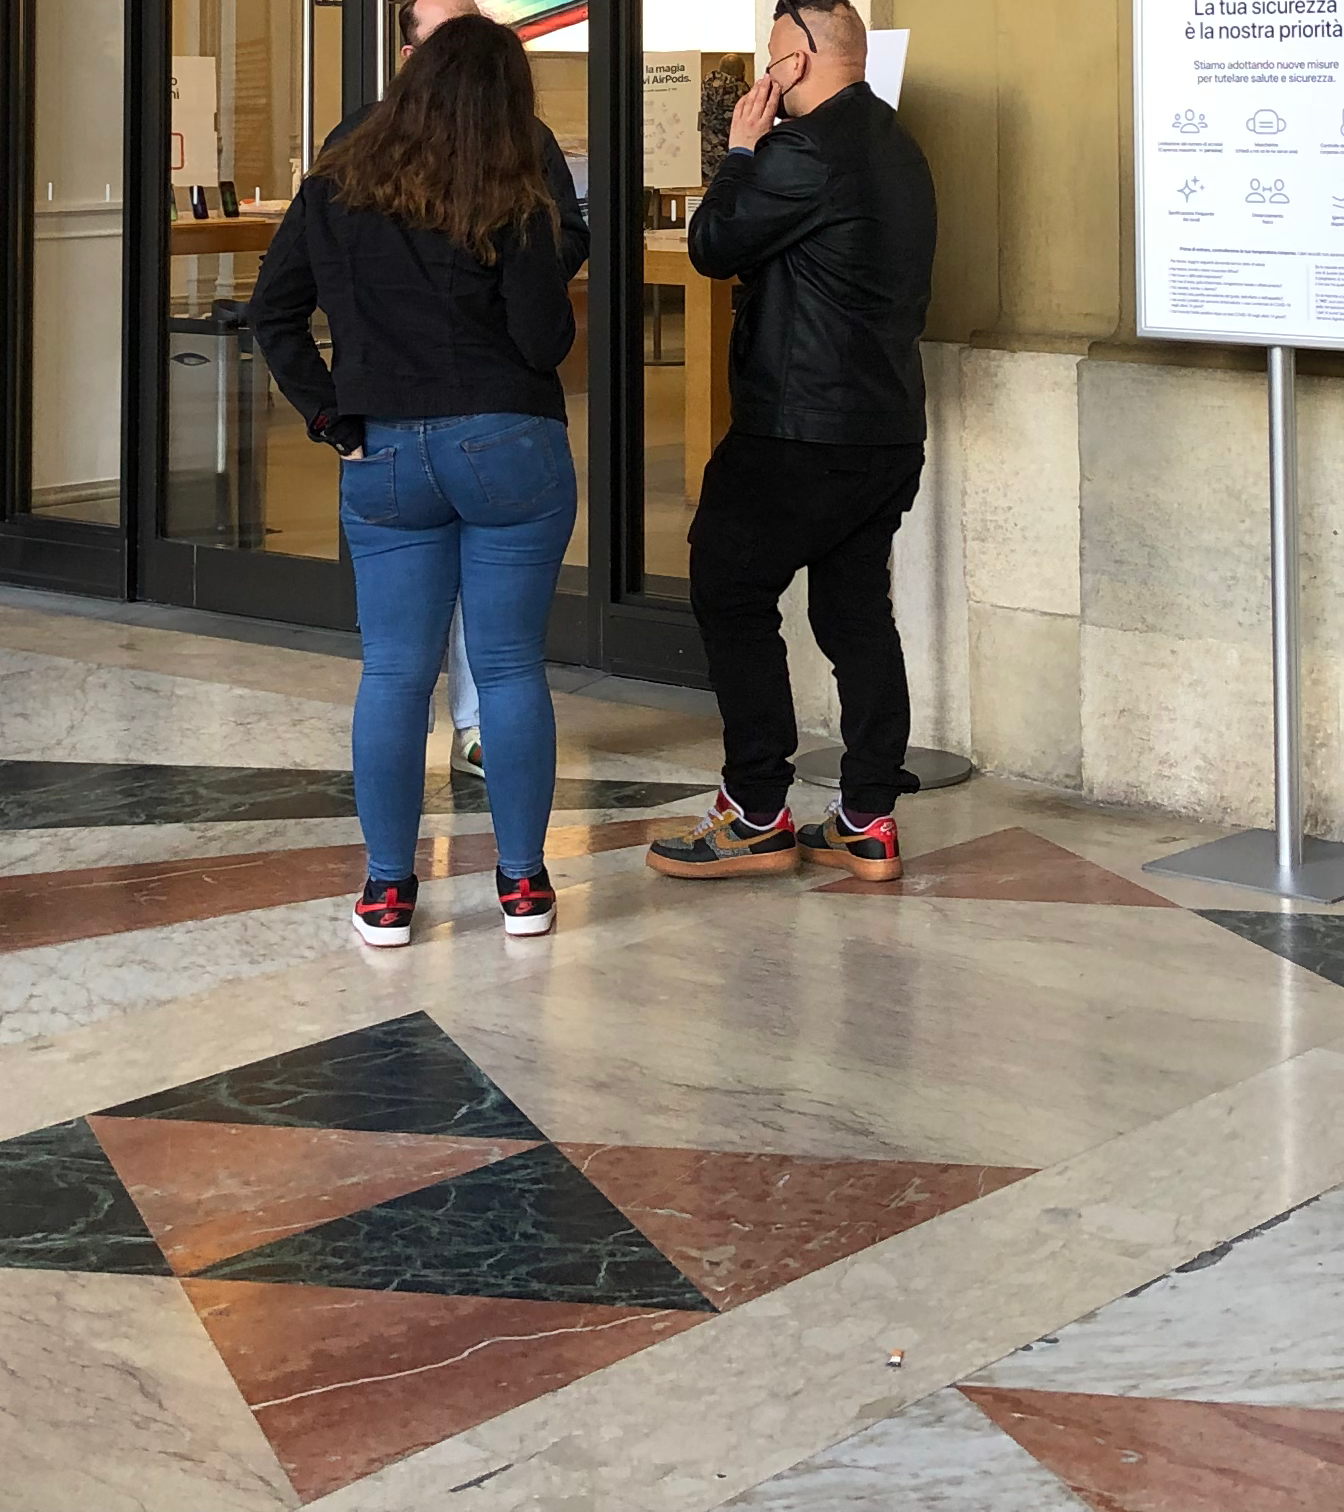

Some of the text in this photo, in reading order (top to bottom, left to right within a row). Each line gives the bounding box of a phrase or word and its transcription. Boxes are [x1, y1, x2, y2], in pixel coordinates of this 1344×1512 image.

[1219, 0, 1247, 15] tua
[1185, 21, 1195, 39] è
[1200, 22, 1214, 39] la
[1219, 22, 1274, 39] nostra
[656, 63, 685, 74] magia
[1193, 59, 1339, 70] Stiamo adottando nuove misure
[652, 74, 691, 84] AirPods.
[1197, 73, 1336, 85] per tutelare salute e sicurezza.
